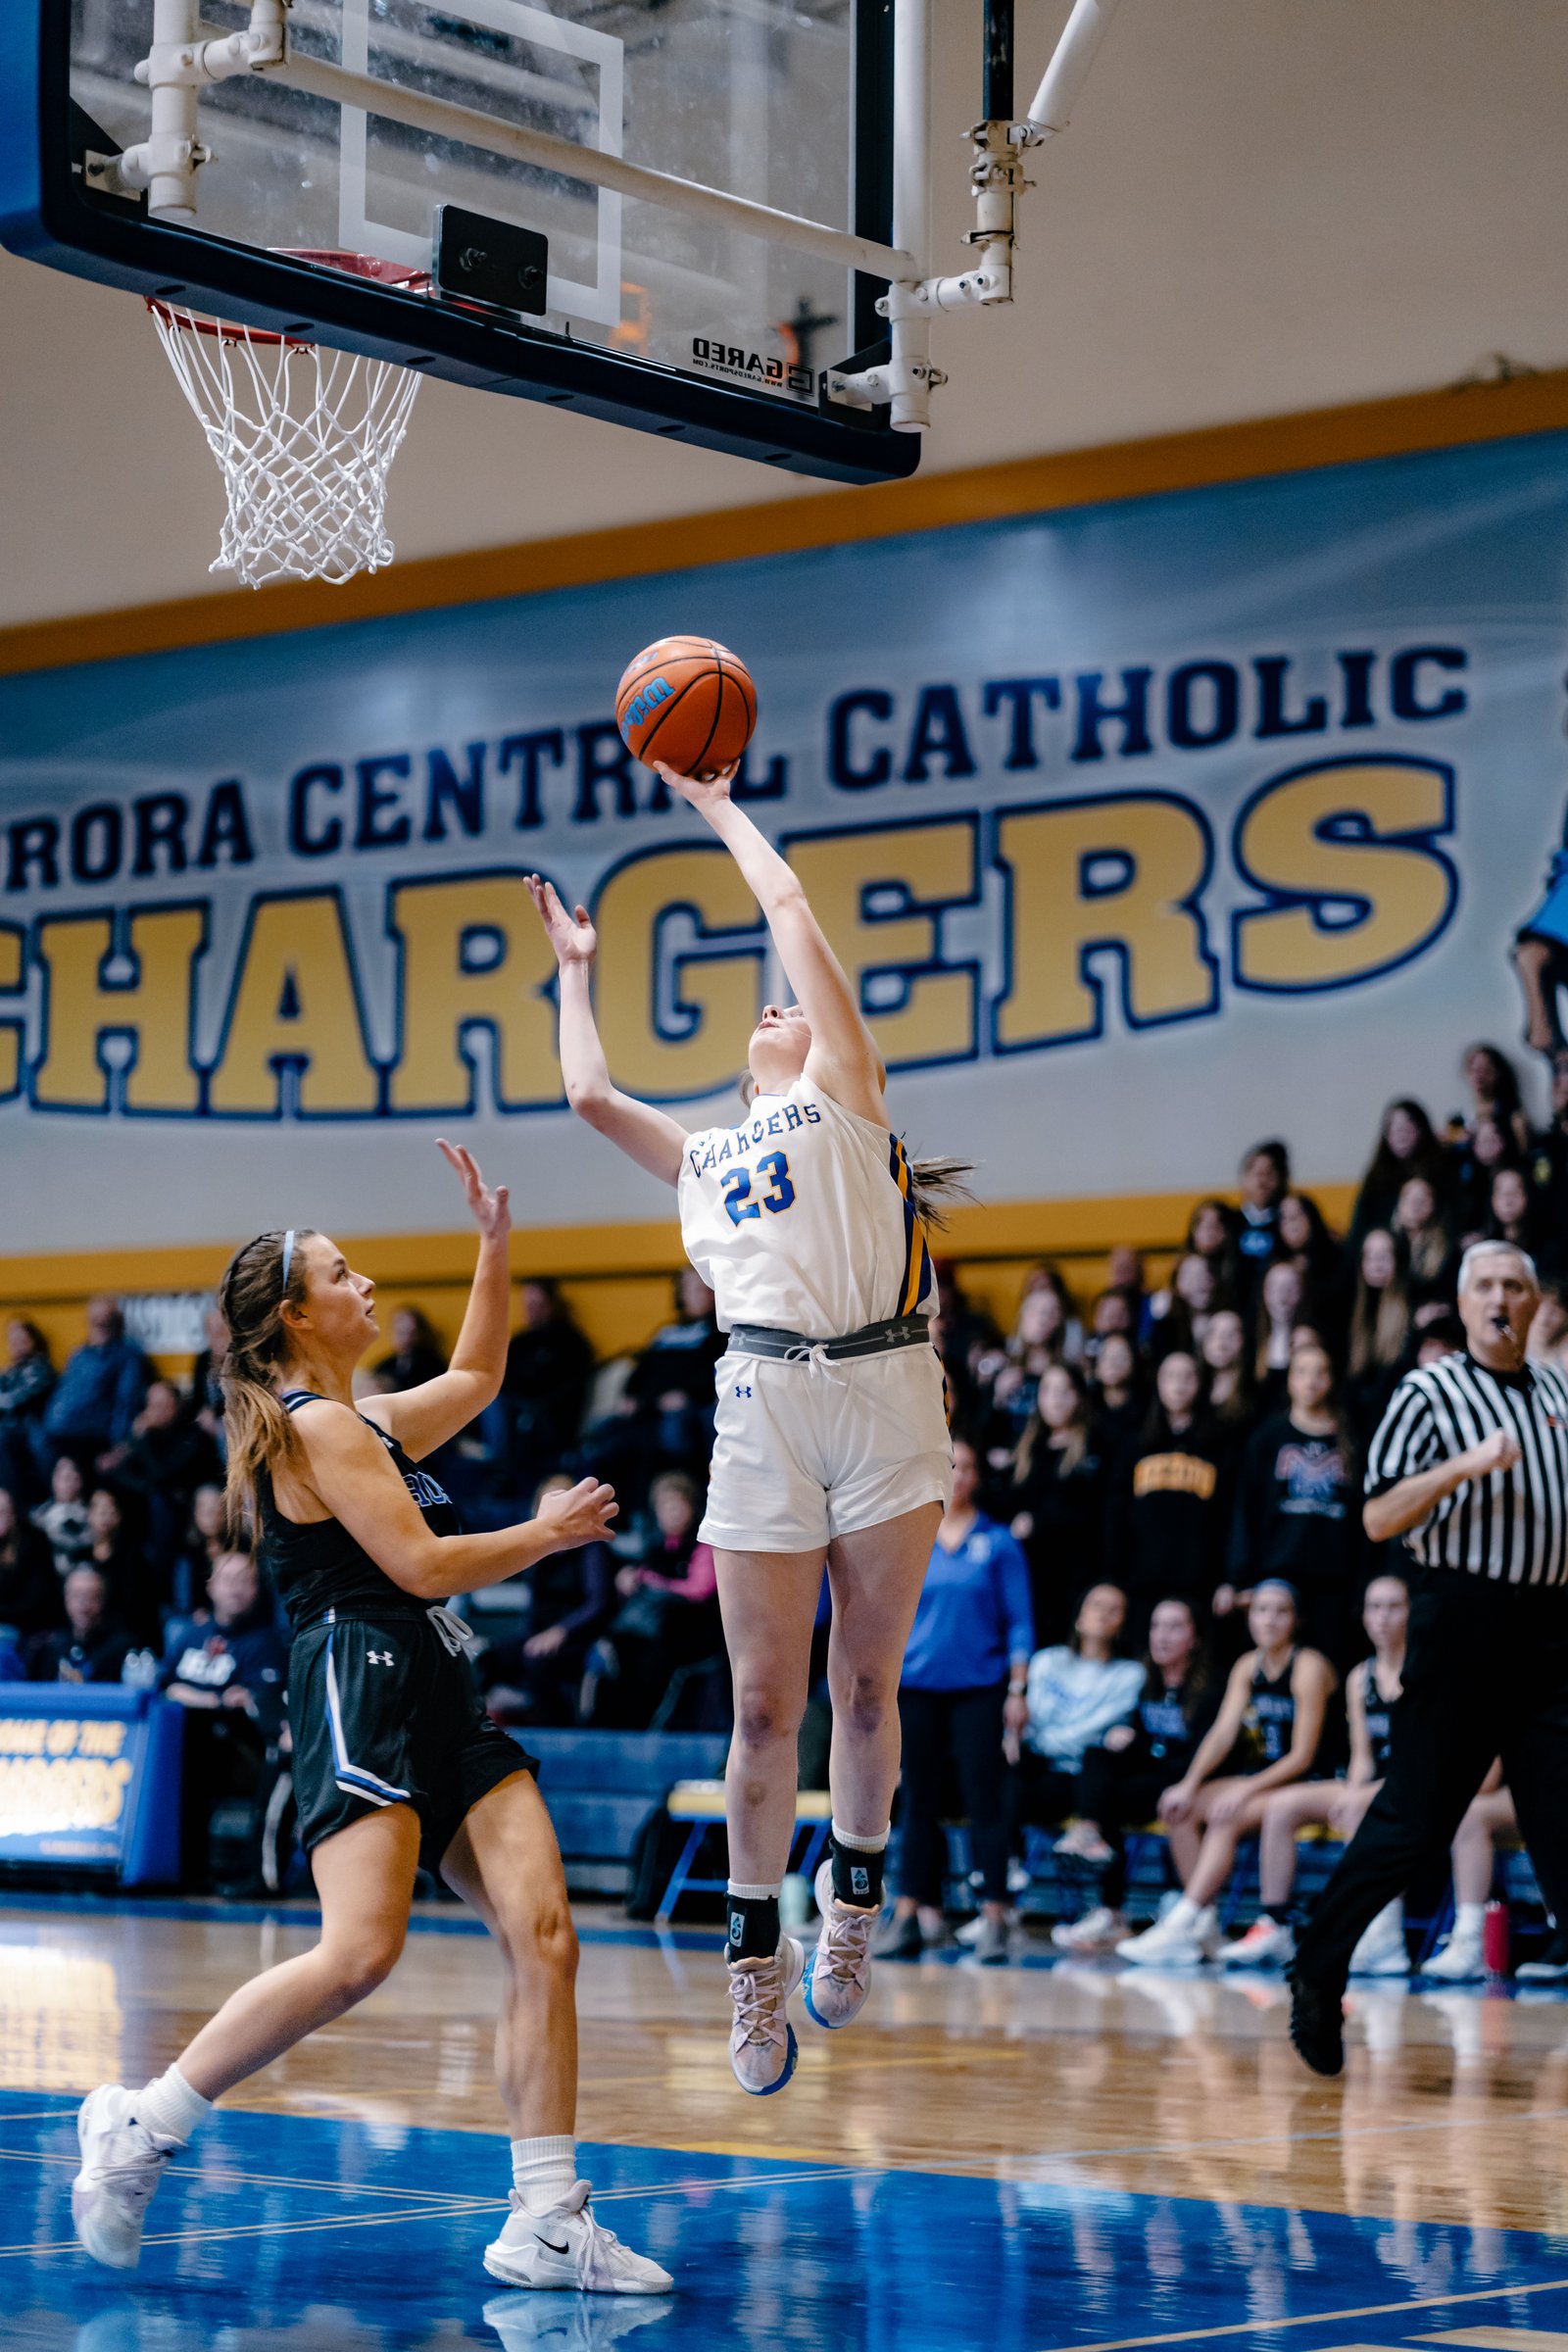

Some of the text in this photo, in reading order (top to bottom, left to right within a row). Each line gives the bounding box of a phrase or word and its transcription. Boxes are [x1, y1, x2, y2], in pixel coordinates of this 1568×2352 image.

[288, 718, 788, 858] CENTRL
[827, 645, 1468, 791] CATHOLIC
[0, 752, 1460, 1118] HARGERS
[719, 1150, 797, 1228] 23
